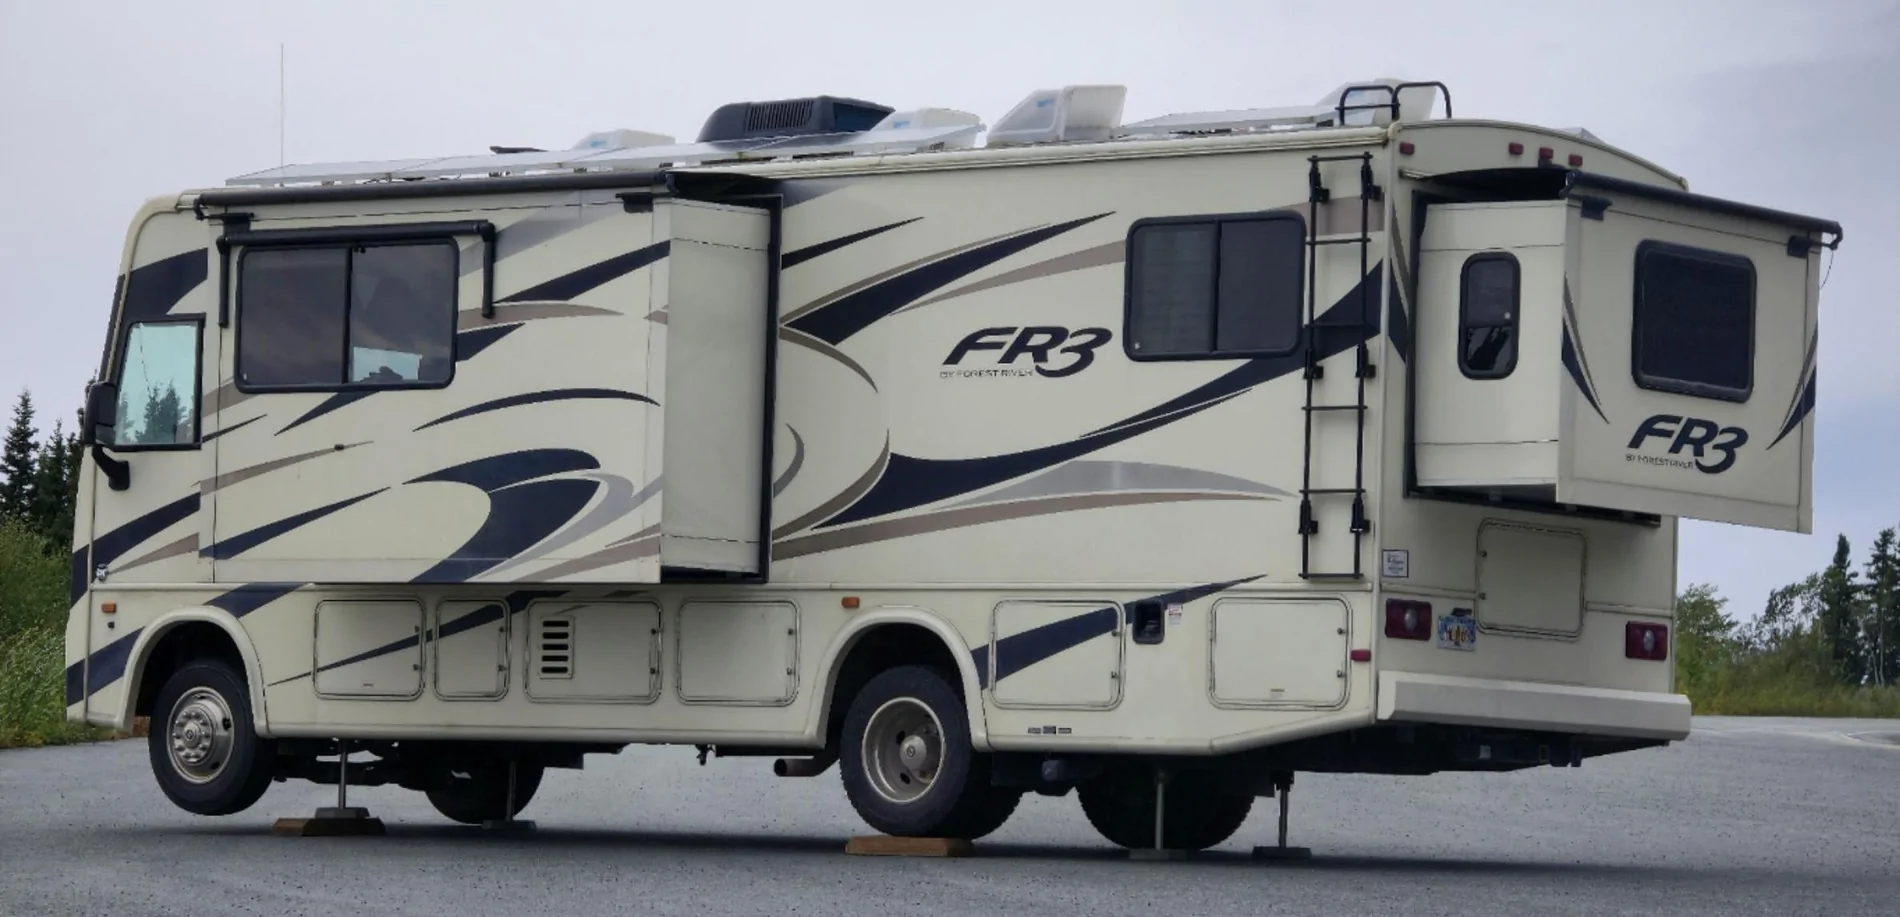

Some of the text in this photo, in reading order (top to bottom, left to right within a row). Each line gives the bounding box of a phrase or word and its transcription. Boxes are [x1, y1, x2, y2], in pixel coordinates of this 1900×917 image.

[940, 369, 1033, 379] BY FOREST RIVER
[942, 326, 1113, 378] FR3
[1627, 414, 1749, 474] FR3
